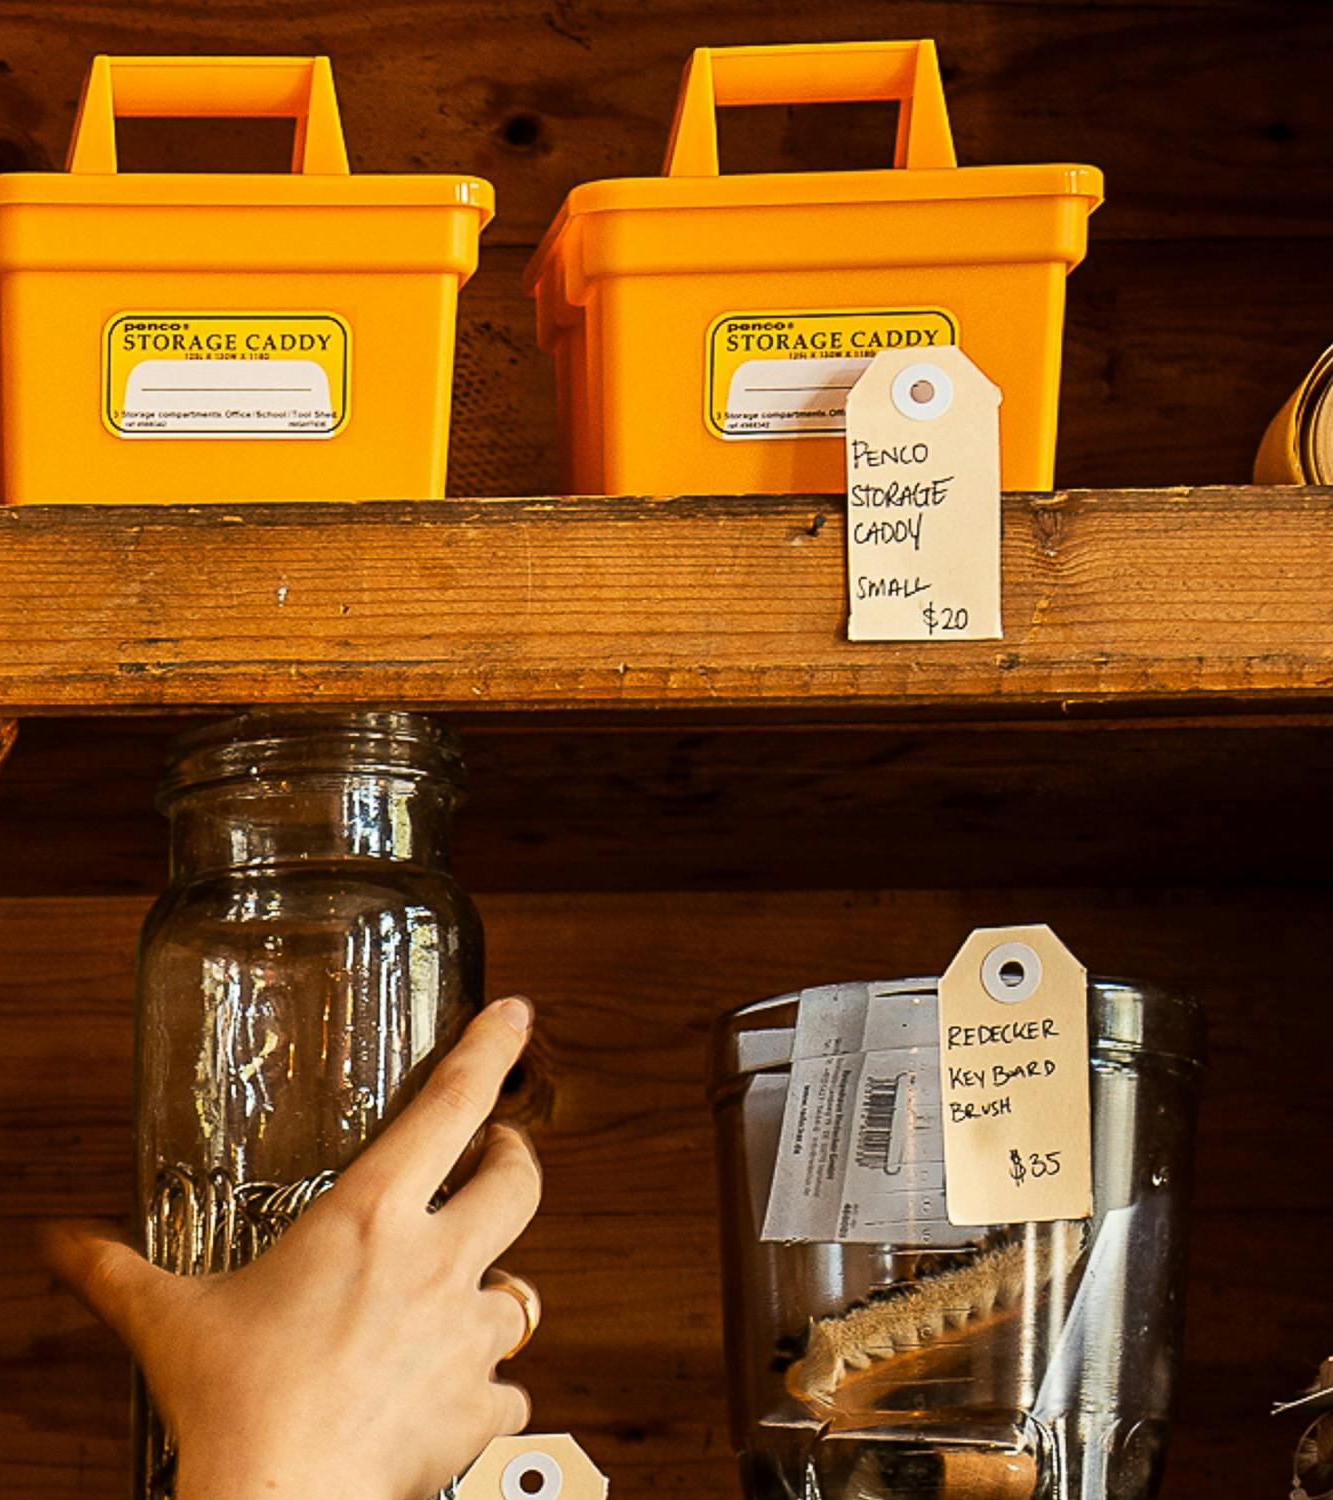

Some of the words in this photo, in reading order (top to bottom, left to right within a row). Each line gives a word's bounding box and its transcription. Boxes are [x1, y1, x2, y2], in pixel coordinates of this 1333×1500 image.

[124, 334, 236, 351] STORAGE
[246, 334, 331, 351] CADDY
[727, 333, 842, 352] STORAGE
[851, 329, 939, 348] CADDY
[851, 440, 929, 468] PENCO
[851, 476, 954, 508] STORAGE
[854, 512, 923, 551] CADDY
[858, 576, 932, 600] SMALL
[923, 601, 969, 635] $20
[948, 1019, 1060, 1050] REDECKER
[950, 1097, 1012, 1123] BRUSH
[1009, 1149, 1061, 1188] $35
